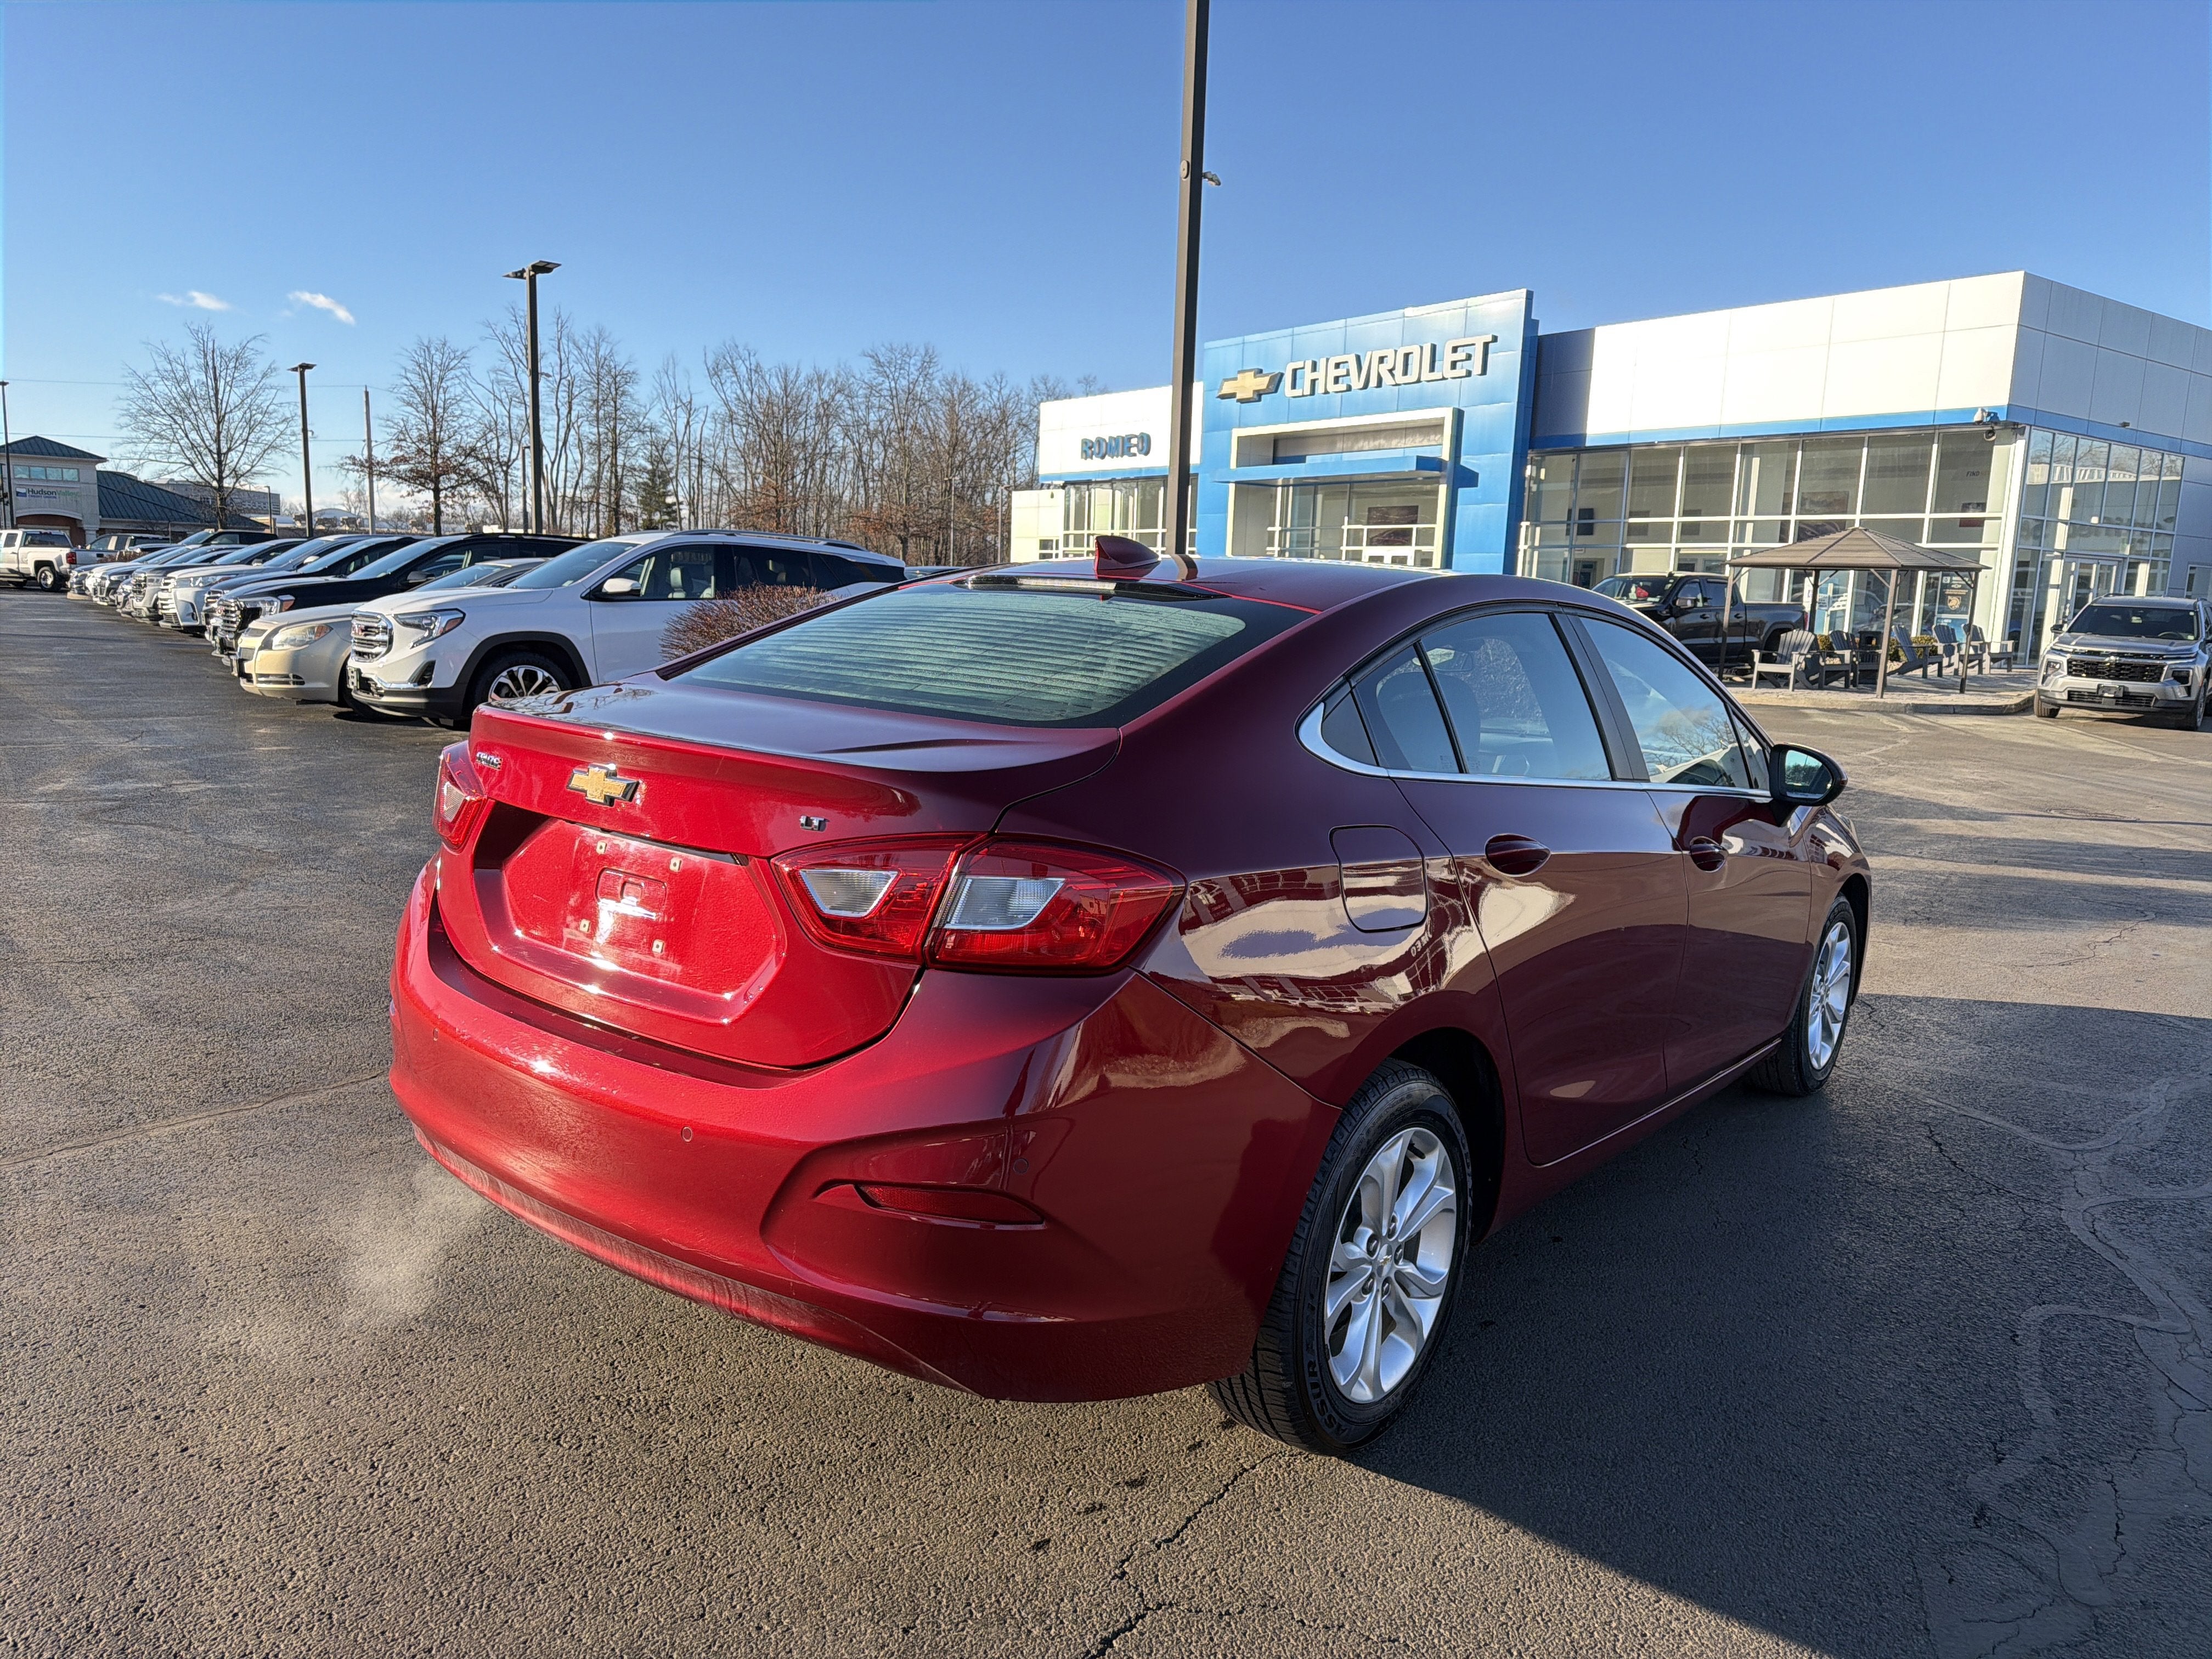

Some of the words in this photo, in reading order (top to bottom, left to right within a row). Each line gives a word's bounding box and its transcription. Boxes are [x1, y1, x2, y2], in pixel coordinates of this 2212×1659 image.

[1284, 334, 1497, 397] CHEVROLET
[1081, 432, 1152, 460] ROMEO
[799, 815, 825, 831] LT
